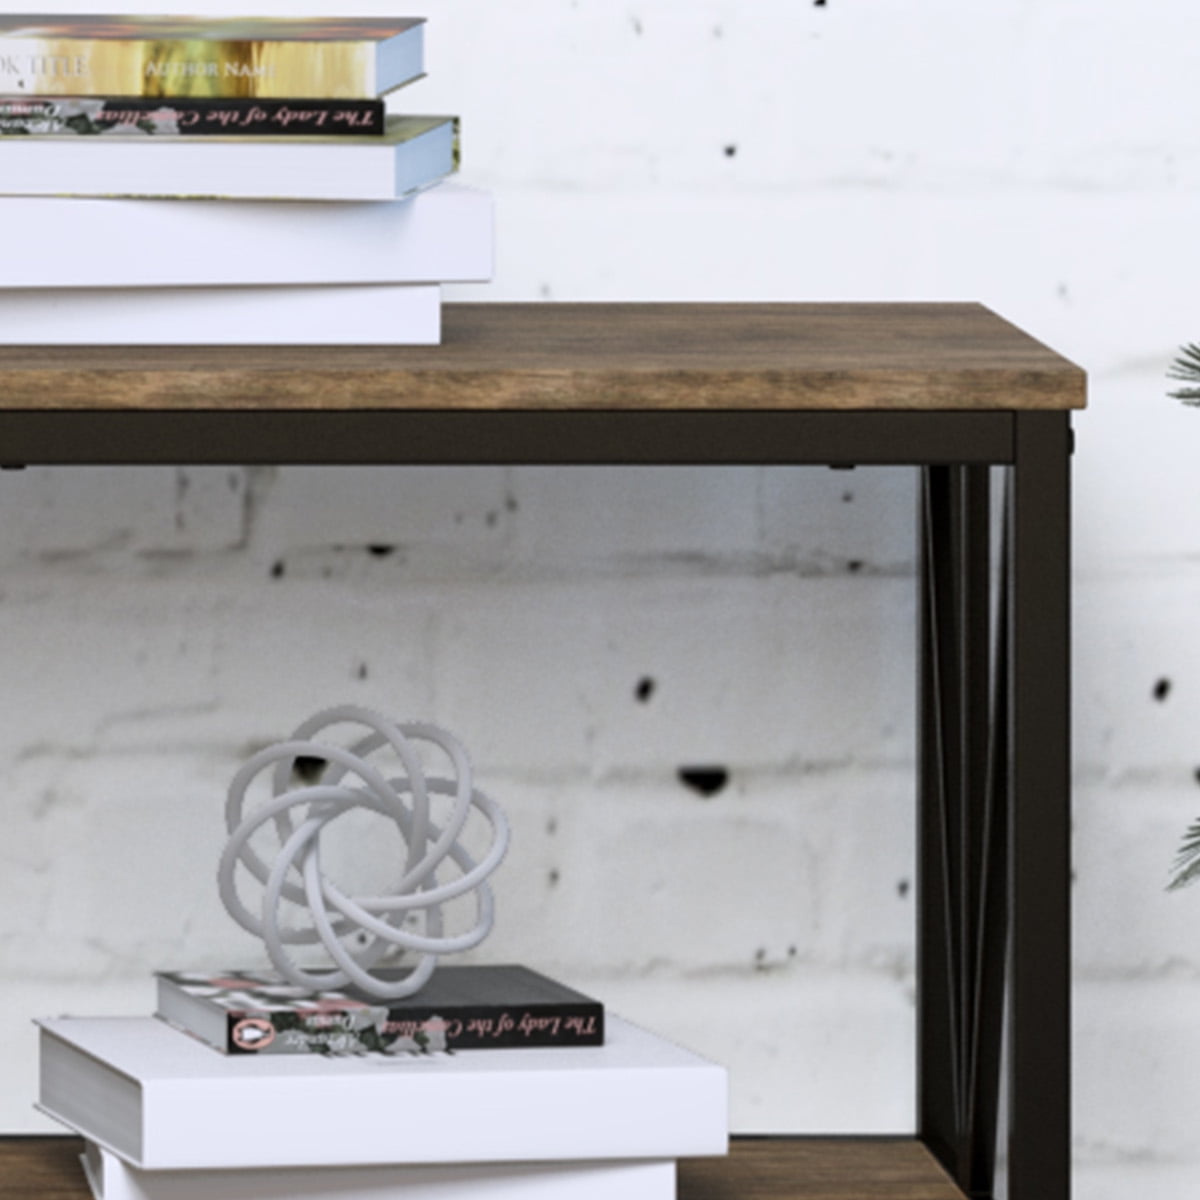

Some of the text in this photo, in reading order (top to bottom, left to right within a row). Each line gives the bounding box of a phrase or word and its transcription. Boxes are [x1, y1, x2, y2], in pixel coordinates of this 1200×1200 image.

[26, 55, 88, 77] TITLE
[207, 109, 240, 127] the
[242, 107, 267, 127] of
[274, 107, 328, 127] Lady
[333, 109, 374, 127] The
[467, 1018, 492, 1038] the
[493, 1013, 514, 1038] of
[517, 1012, 562, 1037] Lady
[565, 1016, 597, 1035] The
